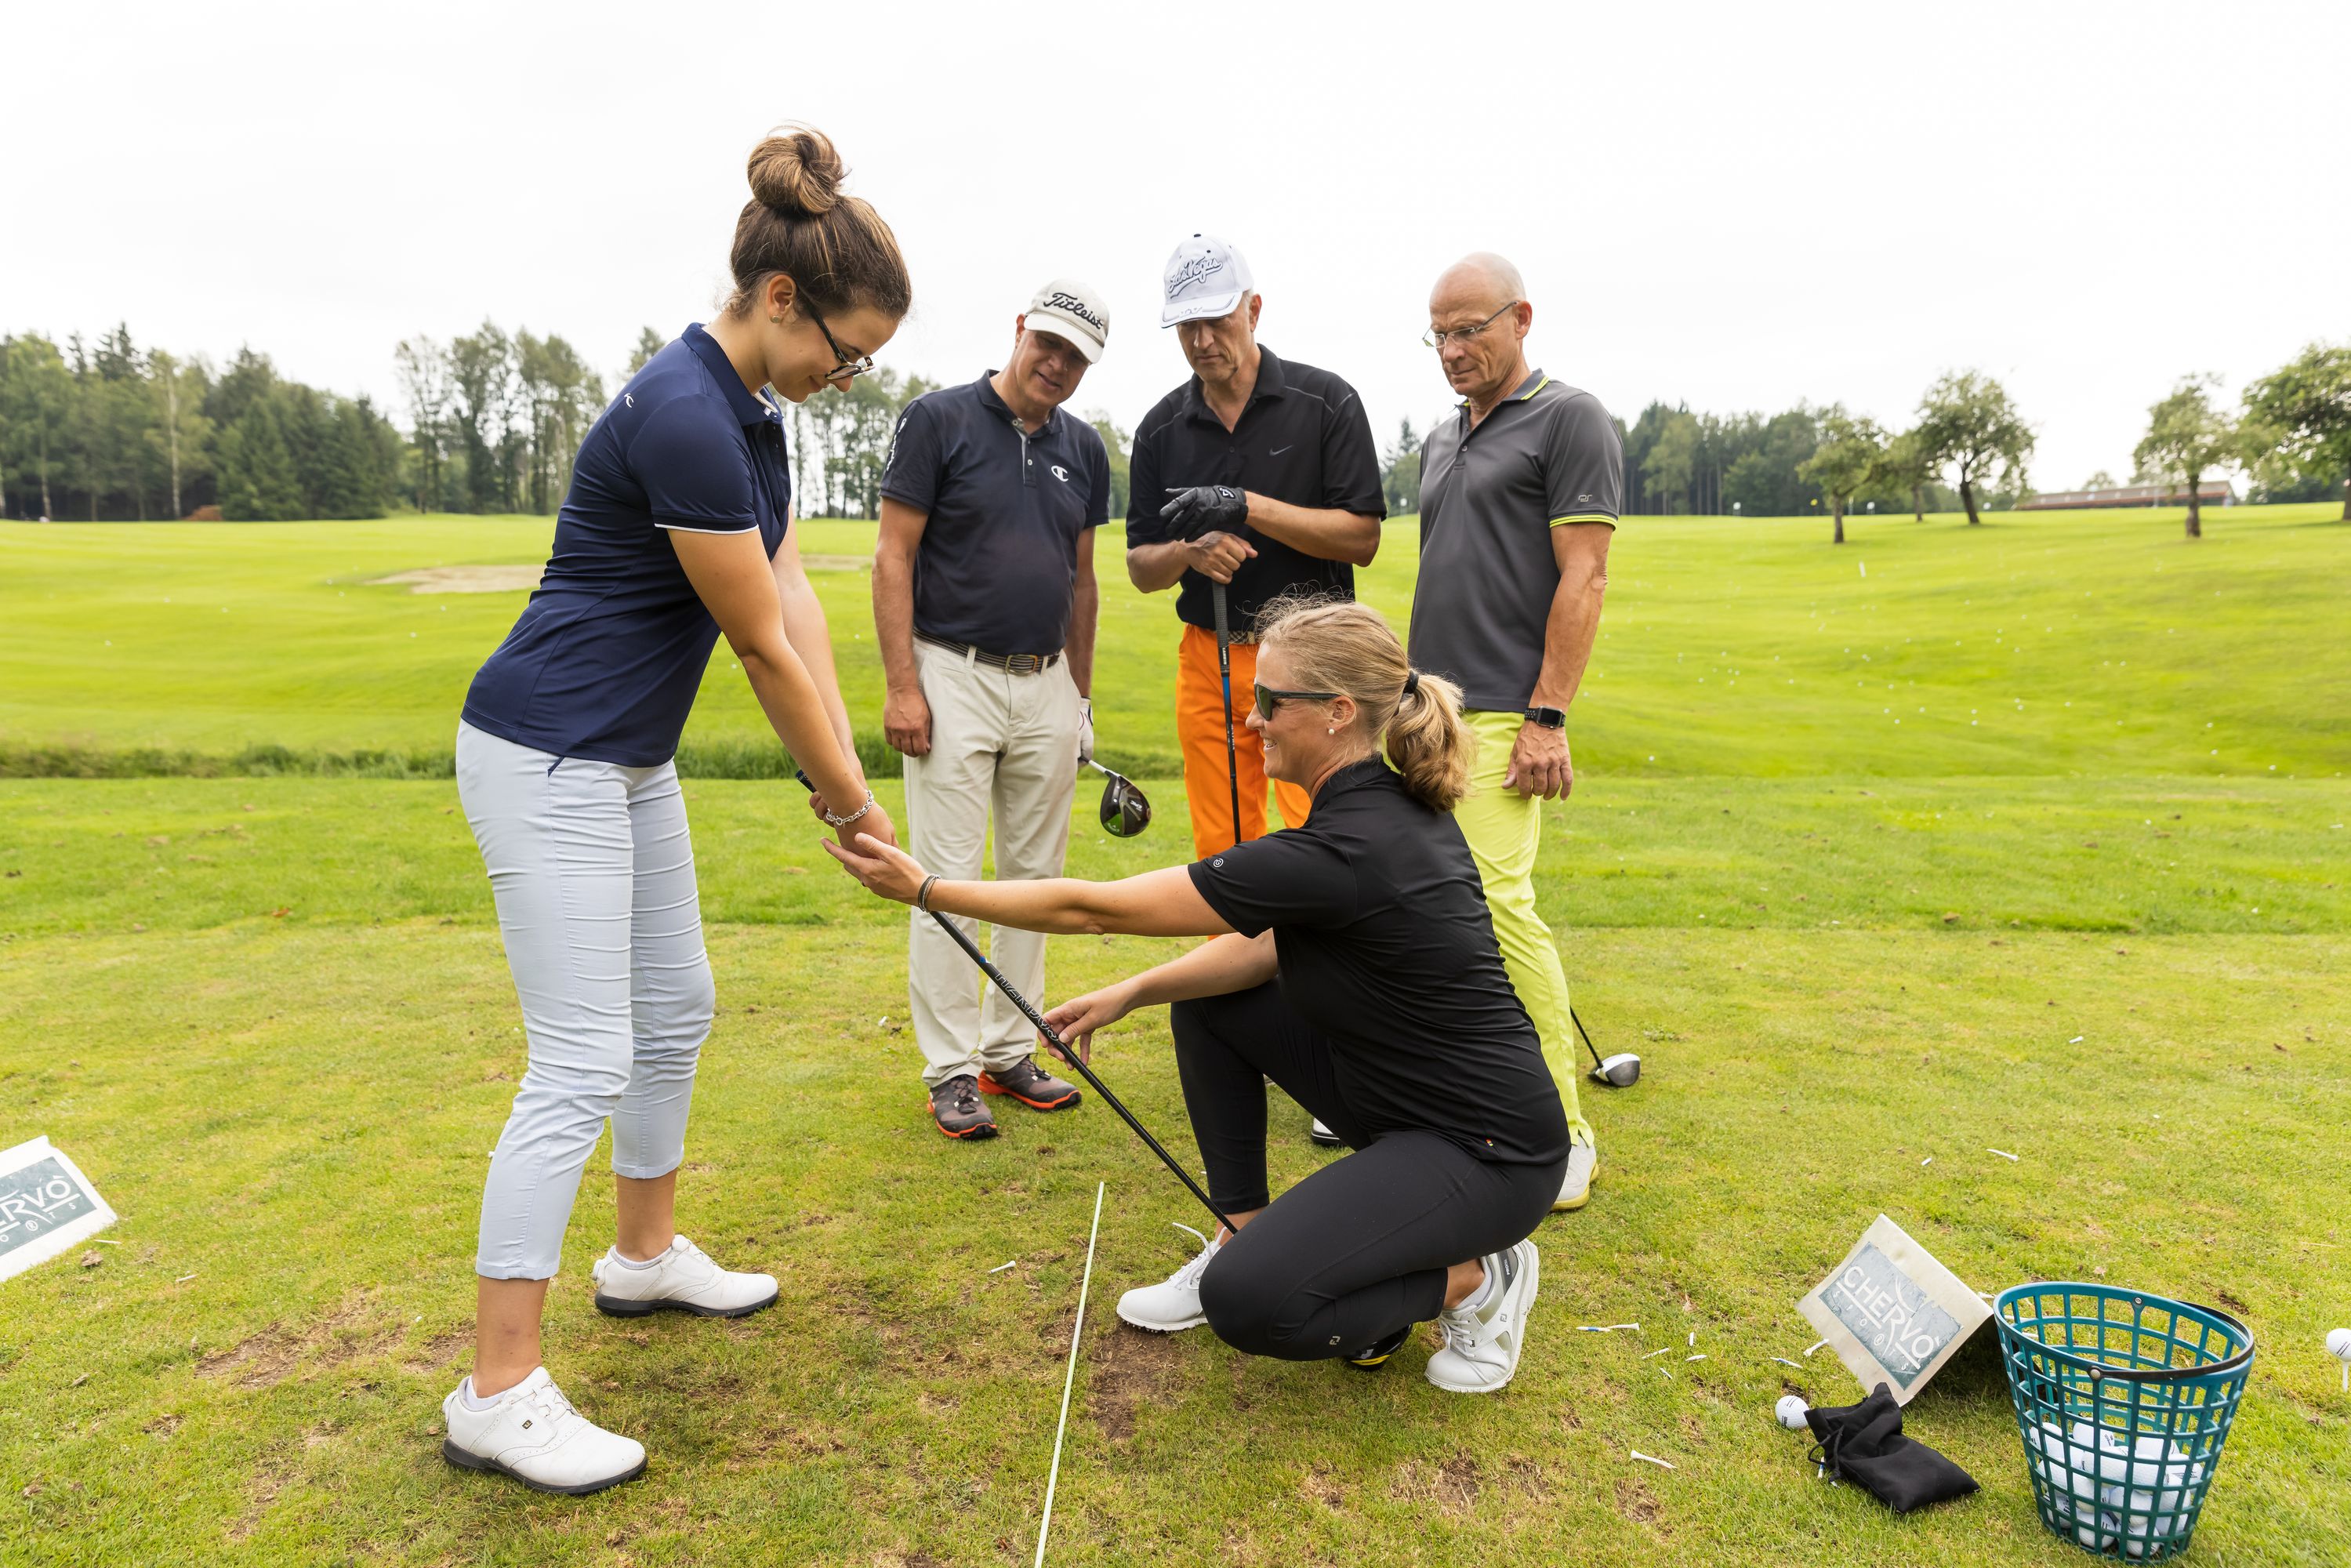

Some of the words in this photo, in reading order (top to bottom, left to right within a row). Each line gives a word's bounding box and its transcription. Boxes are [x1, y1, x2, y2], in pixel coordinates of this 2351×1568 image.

[1168, 270, 1190, 293] Las
[1185, 256, 1222, 284] Vegas
[1043, 292, 1103, 329] Titleist
